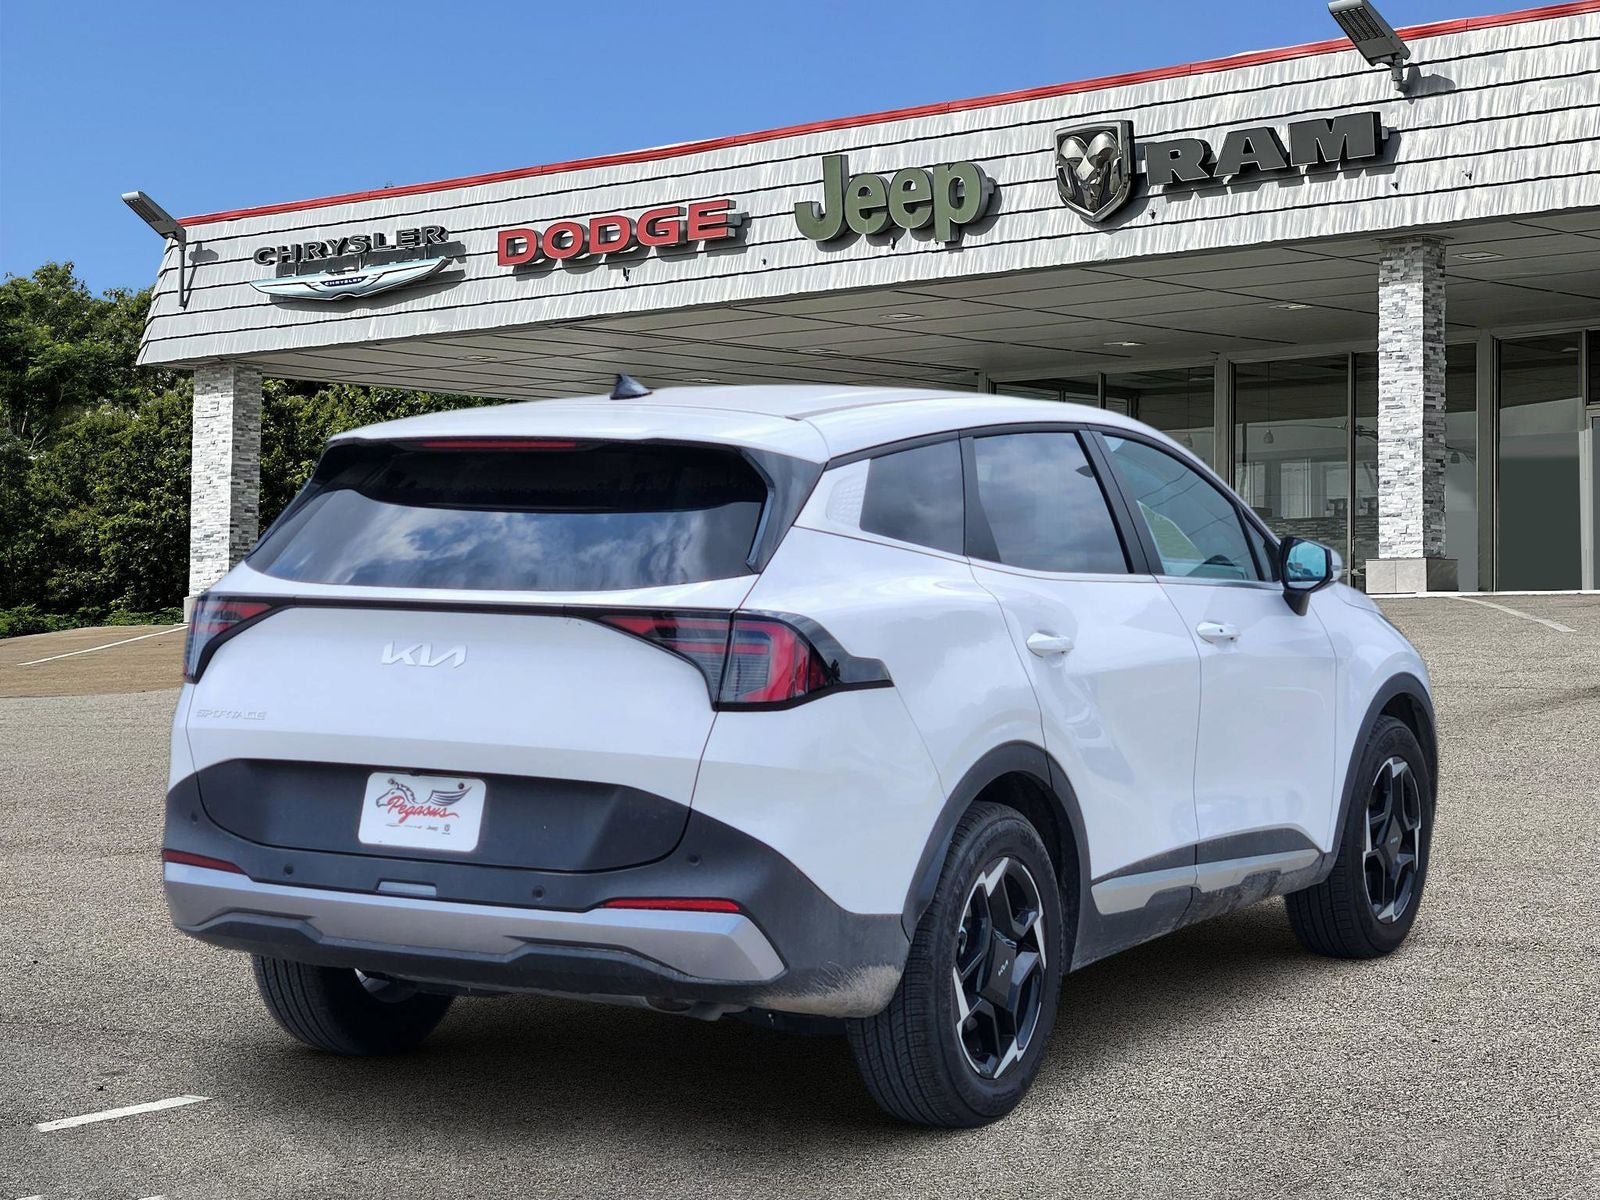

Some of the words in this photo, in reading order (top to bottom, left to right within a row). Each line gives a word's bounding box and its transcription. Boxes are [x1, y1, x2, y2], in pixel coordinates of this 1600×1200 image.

[1145, 111, 1379, 186] RAM
[794, 154, 987, 242] Jeep
[253, 225, 448, 266] CHRYSLER
[497, 199, 736, 267] DODGE
[324, 277, 363, 286] CHRYSLER
[387, 795, 460, 824] Pegasus
